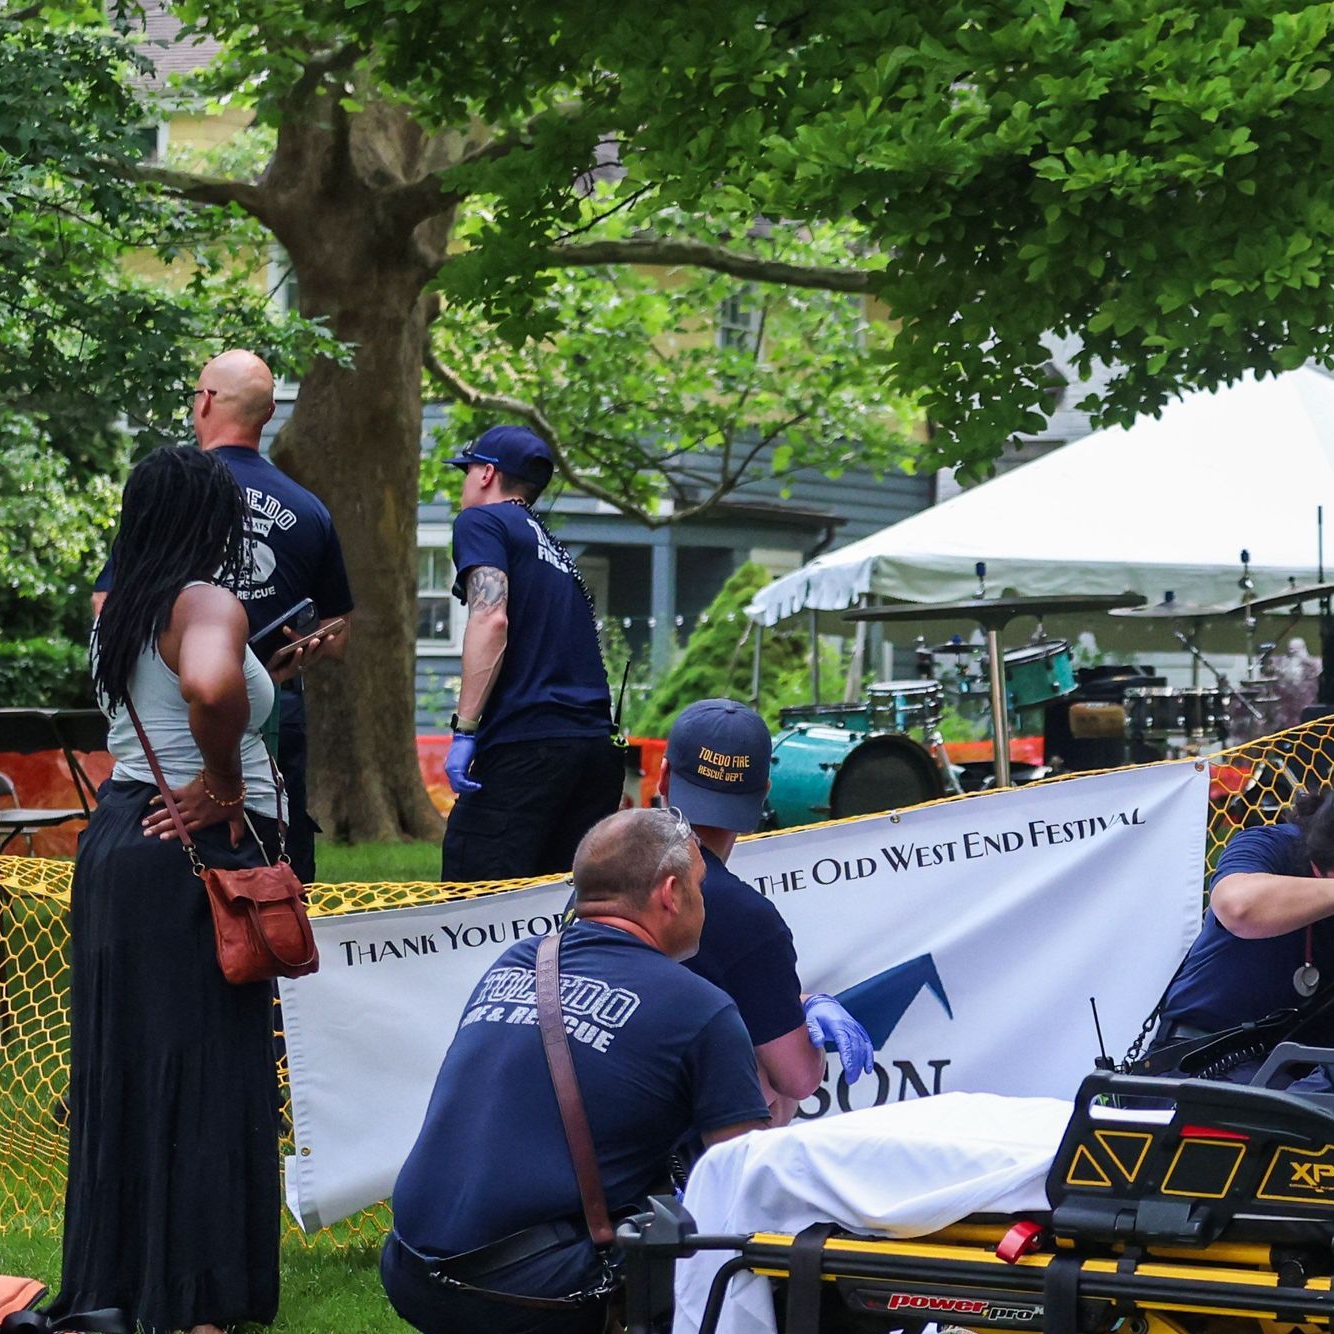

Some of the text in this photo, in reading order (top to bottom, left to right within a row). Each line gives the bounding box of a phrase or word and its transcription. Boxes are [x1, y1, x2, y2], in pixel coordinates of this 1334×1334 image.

[245, 487, 298, 531] EDO
[698, 746, 751, 768] TOLEDO FIRE
[697, 764, 725, 781] RESCUE
[339, 933, 440, 966] THANK
[441, 923, 507, 950] YOU
[754, 870, 805, 895] THE
[812, 857, 877, 884] OLD
[880, 841, 958, 872] WEST
[963, 831, 1025, 859] END
[1028, 807, 1147, 847] FESTIVAL
[485, 1006, 506, 1022] &
[793, 1059, 952, 1121] SON
[887, 1293, 990, 1315] power
